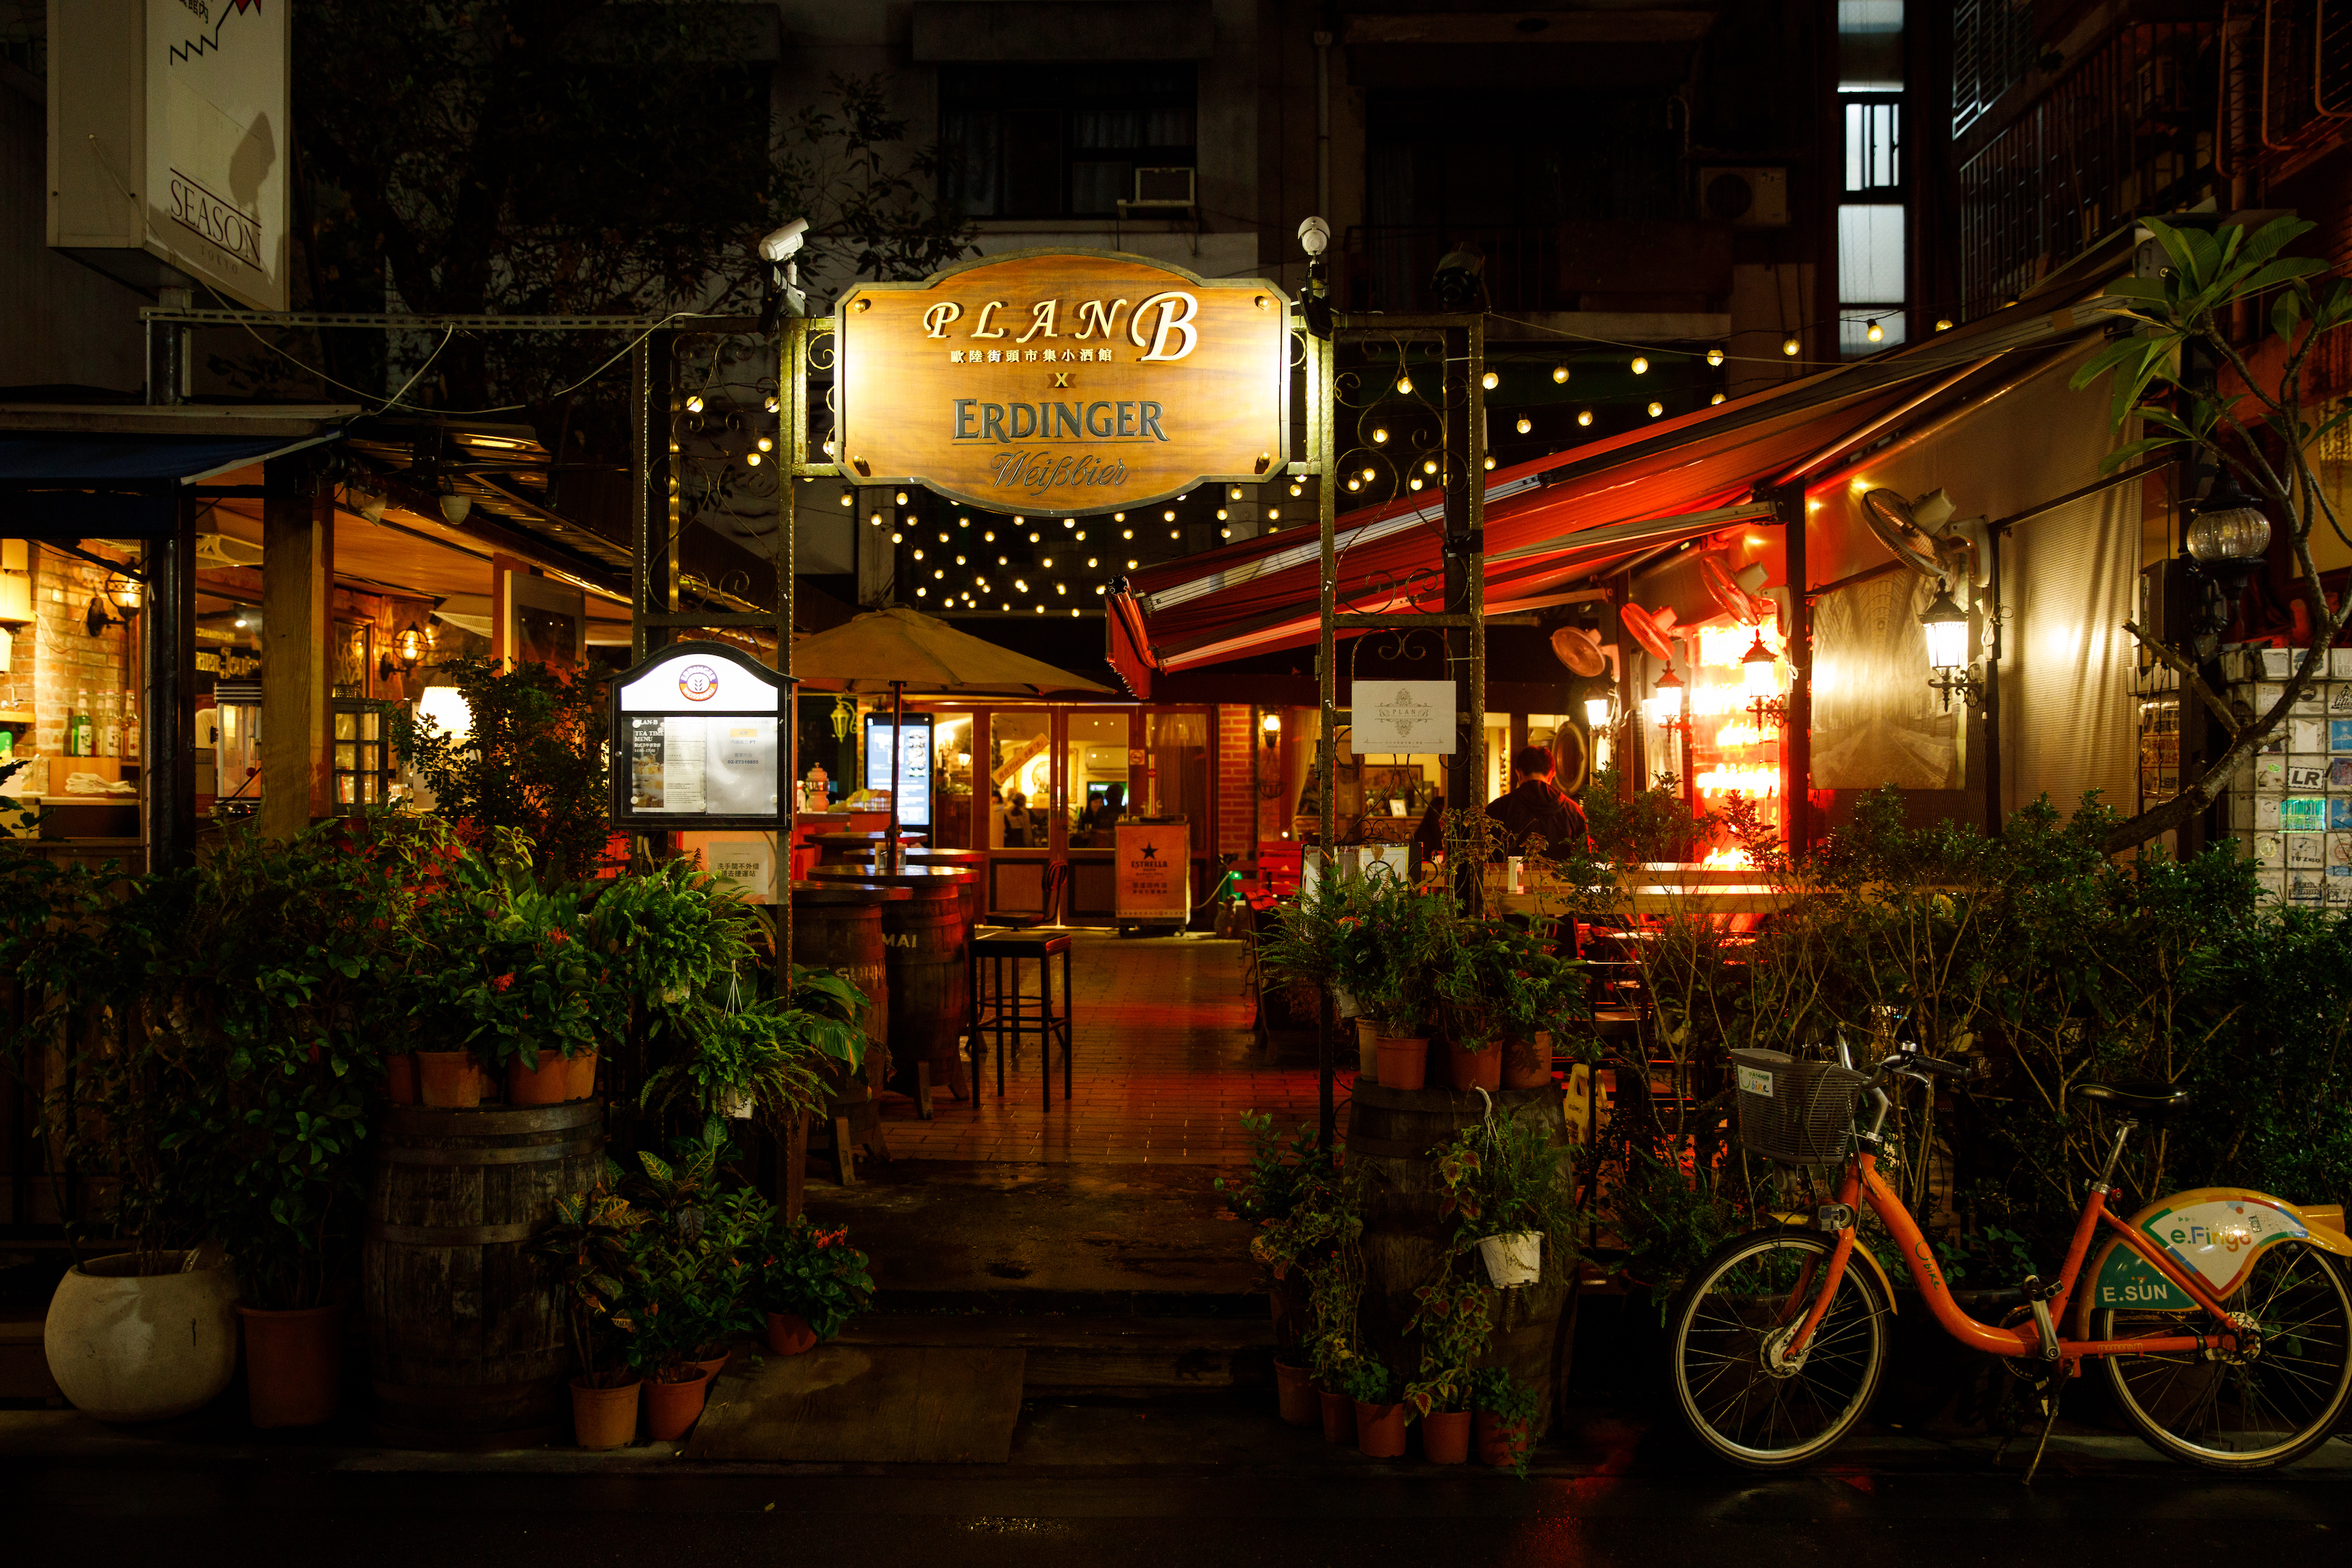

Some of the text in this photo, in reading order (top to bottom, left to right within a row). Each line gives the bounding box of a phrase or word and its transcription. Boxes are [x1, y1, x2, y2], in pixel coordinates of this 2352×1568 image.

[171, 179, 261, 265] SEASON
[200, 244, 238, 275] TOKYO
[923, 290, 1199, 363] PLAN B
[950, 348, 1113, 364] 歐陸街頭市集小酒館
[951, 399, 1171, 444] ERDINGER
[990, 449, 1131, 497] Weißbier
[2291, 770, 2320, 786] LR
[2170, 1225, 2251, 1253] e.Fingo
[2102, 1283, 2168, 1302] E.SUN
